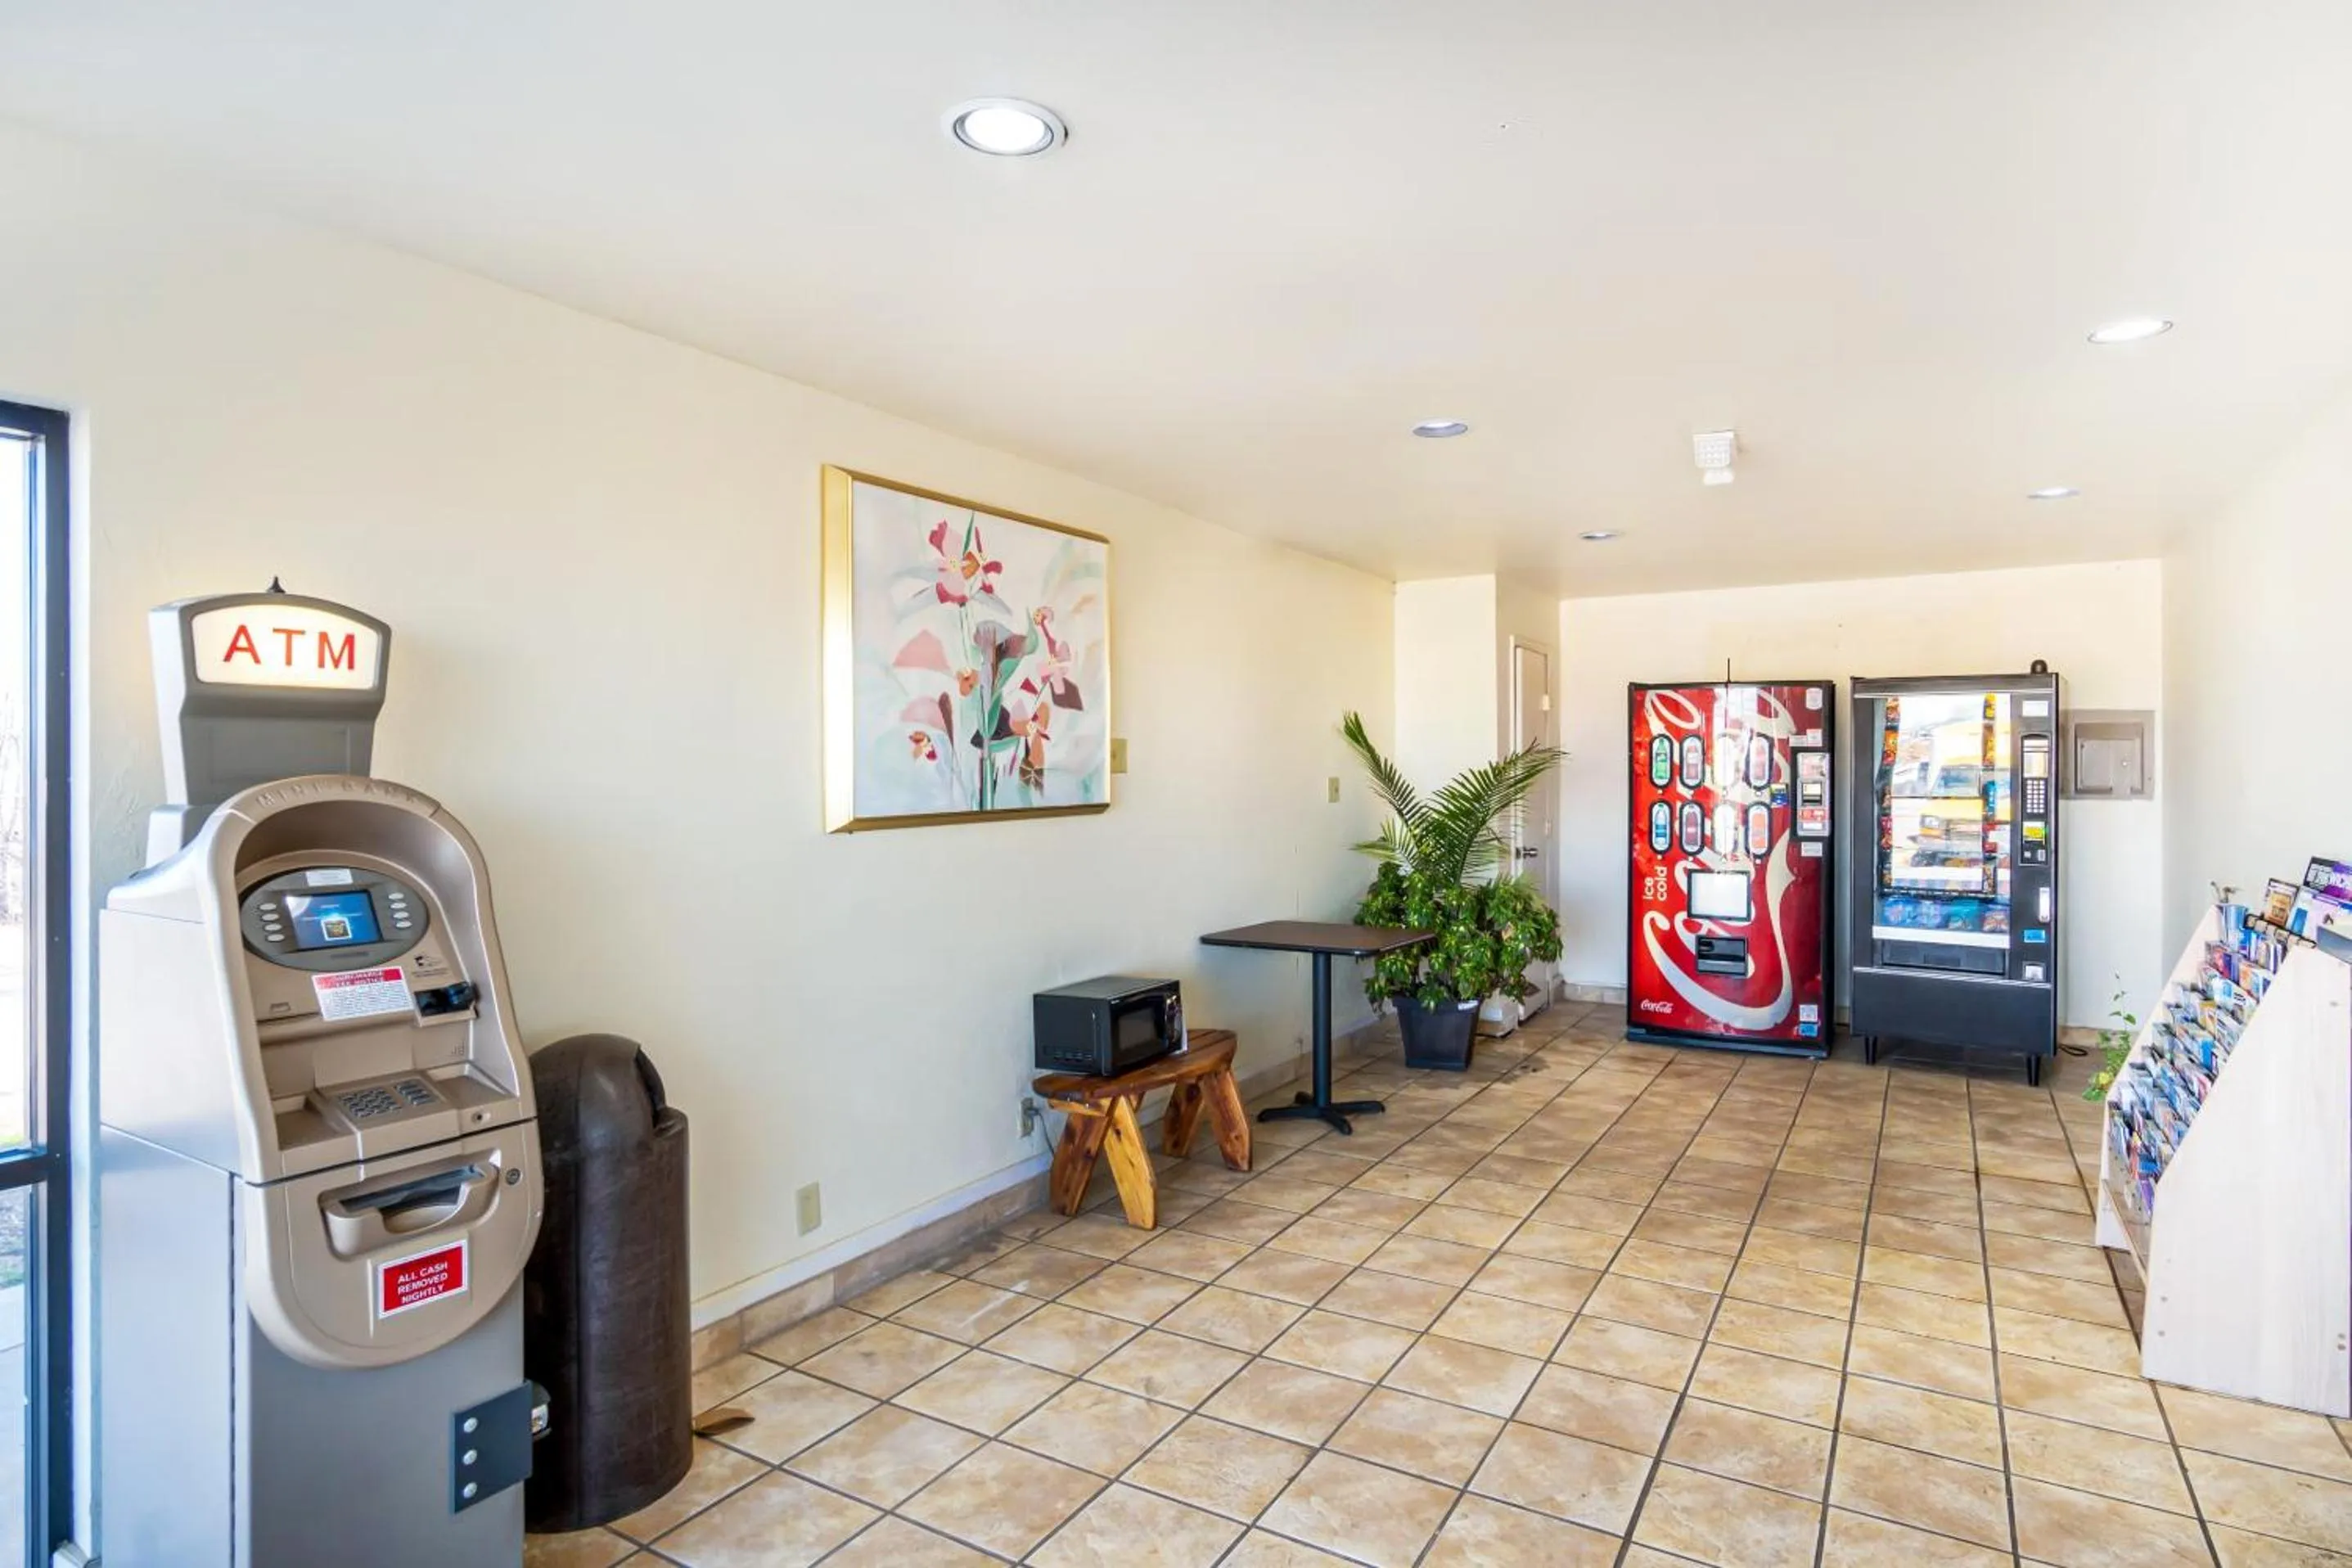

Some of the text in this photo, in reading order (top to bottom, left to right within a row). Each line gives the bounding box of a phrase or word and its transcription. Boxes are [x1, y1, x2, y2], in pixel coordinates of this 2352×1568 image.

[223, 624, 355, 671] ATM
[1654, 865, 1668, 901] cold
[397, 1261, 448, 1284] ALL CASH
[398, 1273, 448, 1295] REMOVED
[402, 1283, 445, 1304] NIGHTLY
